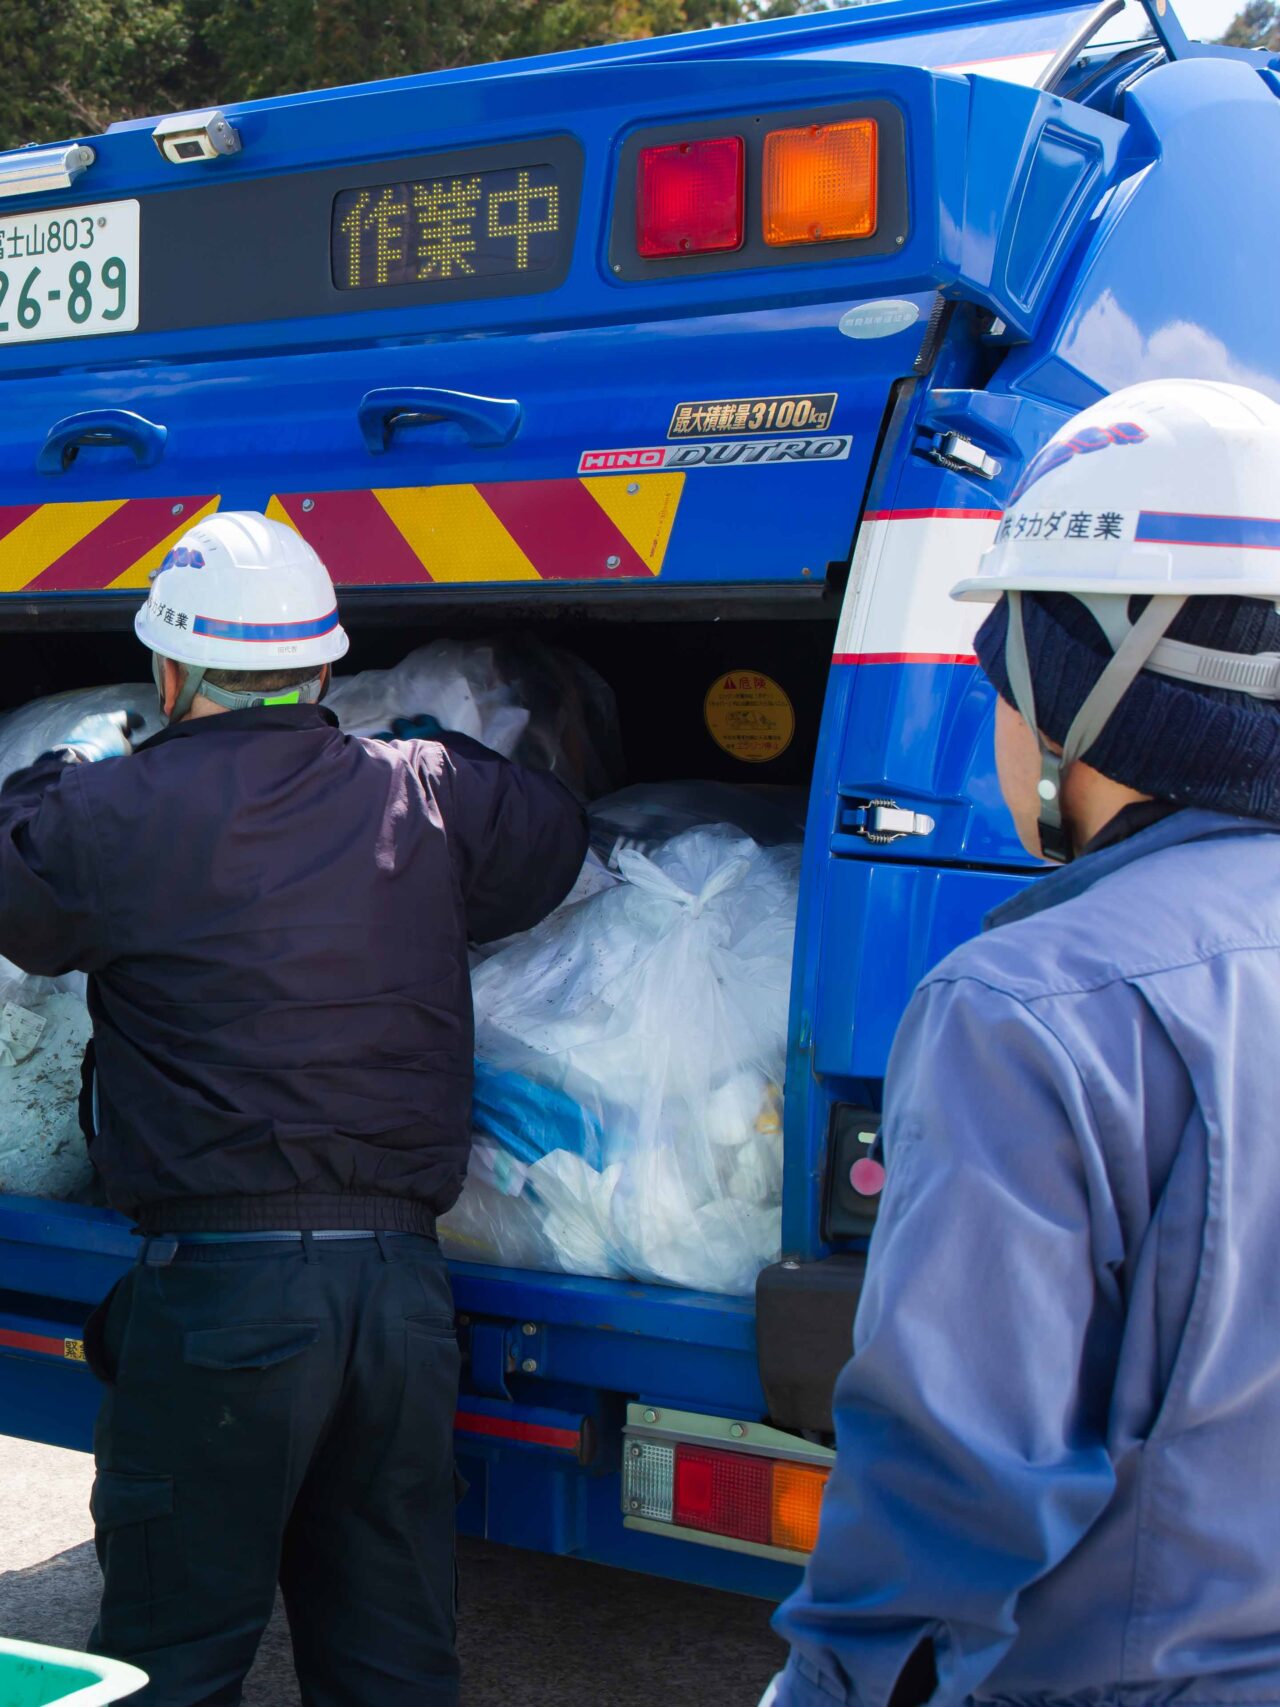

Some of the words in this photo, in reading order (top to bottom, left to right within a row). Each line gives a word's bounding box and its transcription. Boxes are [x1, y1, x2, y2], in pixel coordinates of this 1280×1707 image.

[341, 171, 559, 286] 作業中
[673, 400, 828, 433] 最大積載量3100kg
[584, 451, 662, 468] HINO
[664, 438, 848, 467] DUTRO
